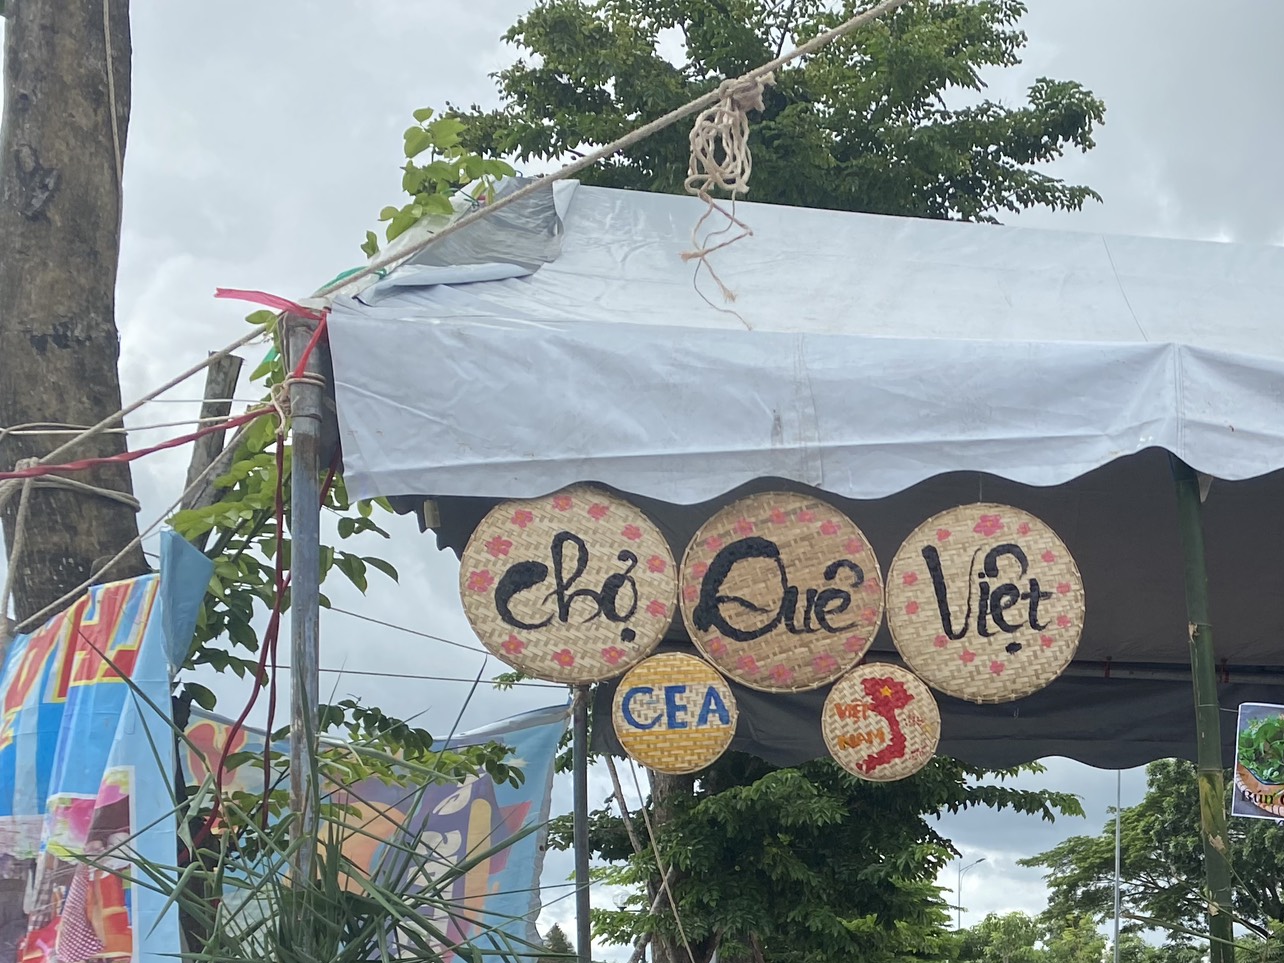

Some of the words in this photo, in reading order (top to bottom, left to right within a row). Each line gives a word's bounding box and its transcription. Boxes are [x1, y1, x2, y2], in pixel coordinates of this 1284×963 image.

[691, 535, 866, 641] Quê
[921, 542, 1054, 655] Việt
[620, 685, 732, 731] CEA
[837, 727, 886, 751] NAM
